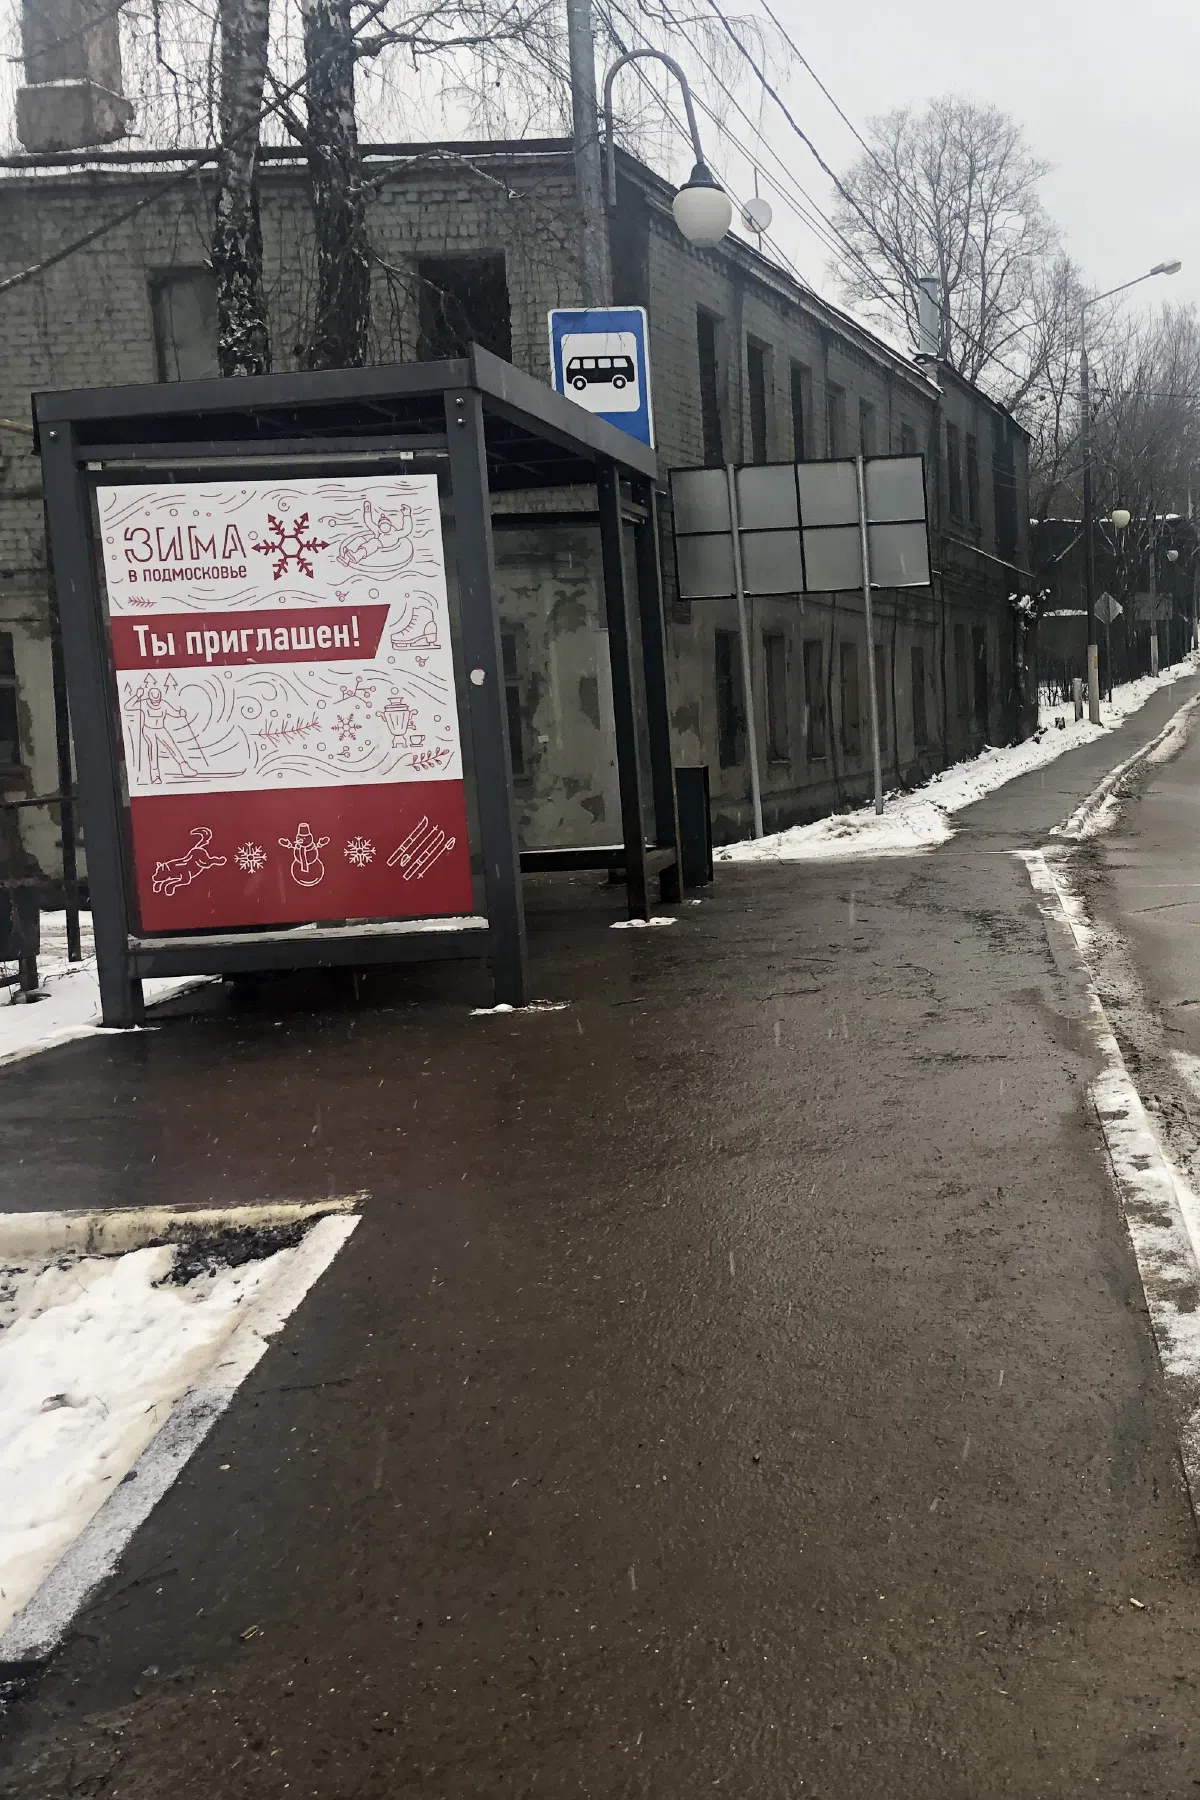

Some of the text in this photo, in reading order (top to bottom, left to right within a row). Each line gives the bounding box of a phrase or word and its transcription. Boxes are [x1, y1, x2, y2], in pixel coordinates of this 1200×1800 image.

[124, 524, 247, 563] ЗИМА
[133, 615, 360, 662] Ты приглашен!
